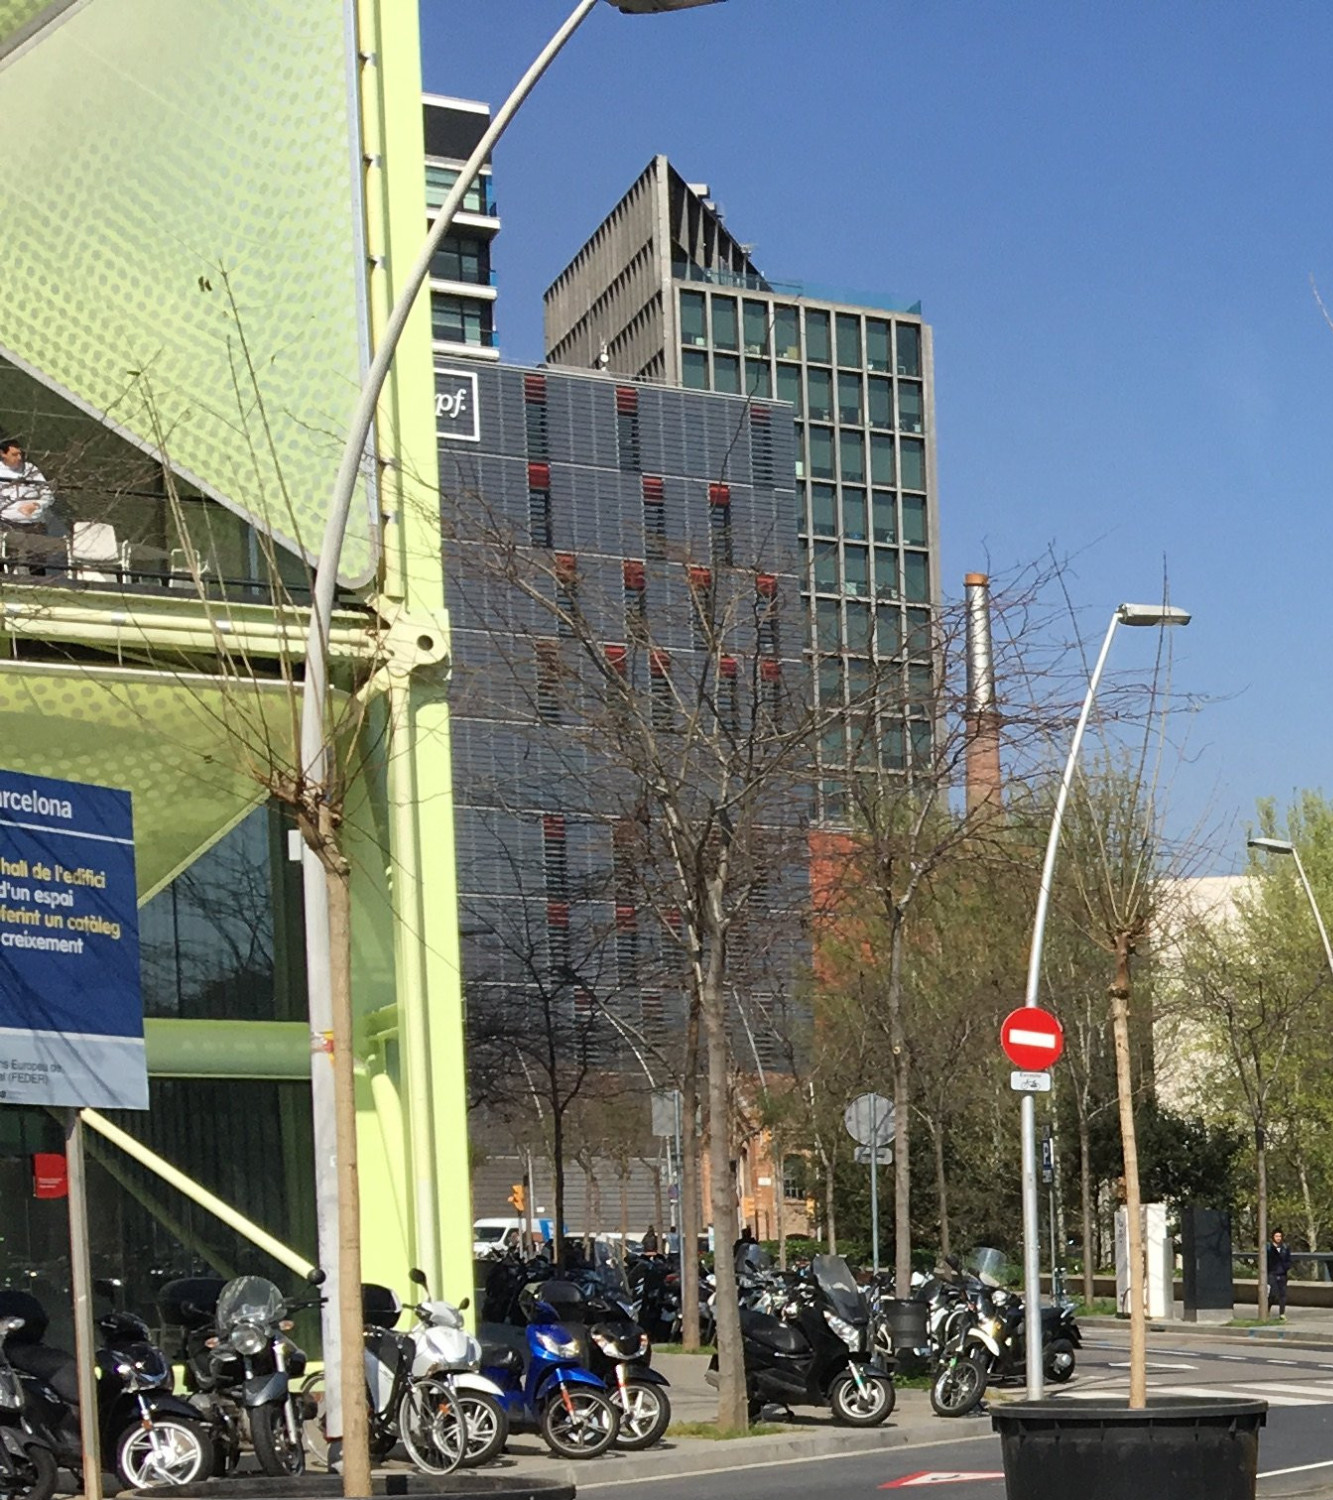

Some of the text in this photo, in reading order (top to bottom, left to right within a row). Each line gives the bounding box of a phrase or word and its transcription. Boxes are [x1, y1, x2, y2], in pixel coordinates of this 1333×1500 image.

[1, 857, 106, 889] hall de l'edifici
[34, 889, 74, 909] espai
[45, 914, 63, 929] un
[1, 929, 84, 955] creixement
